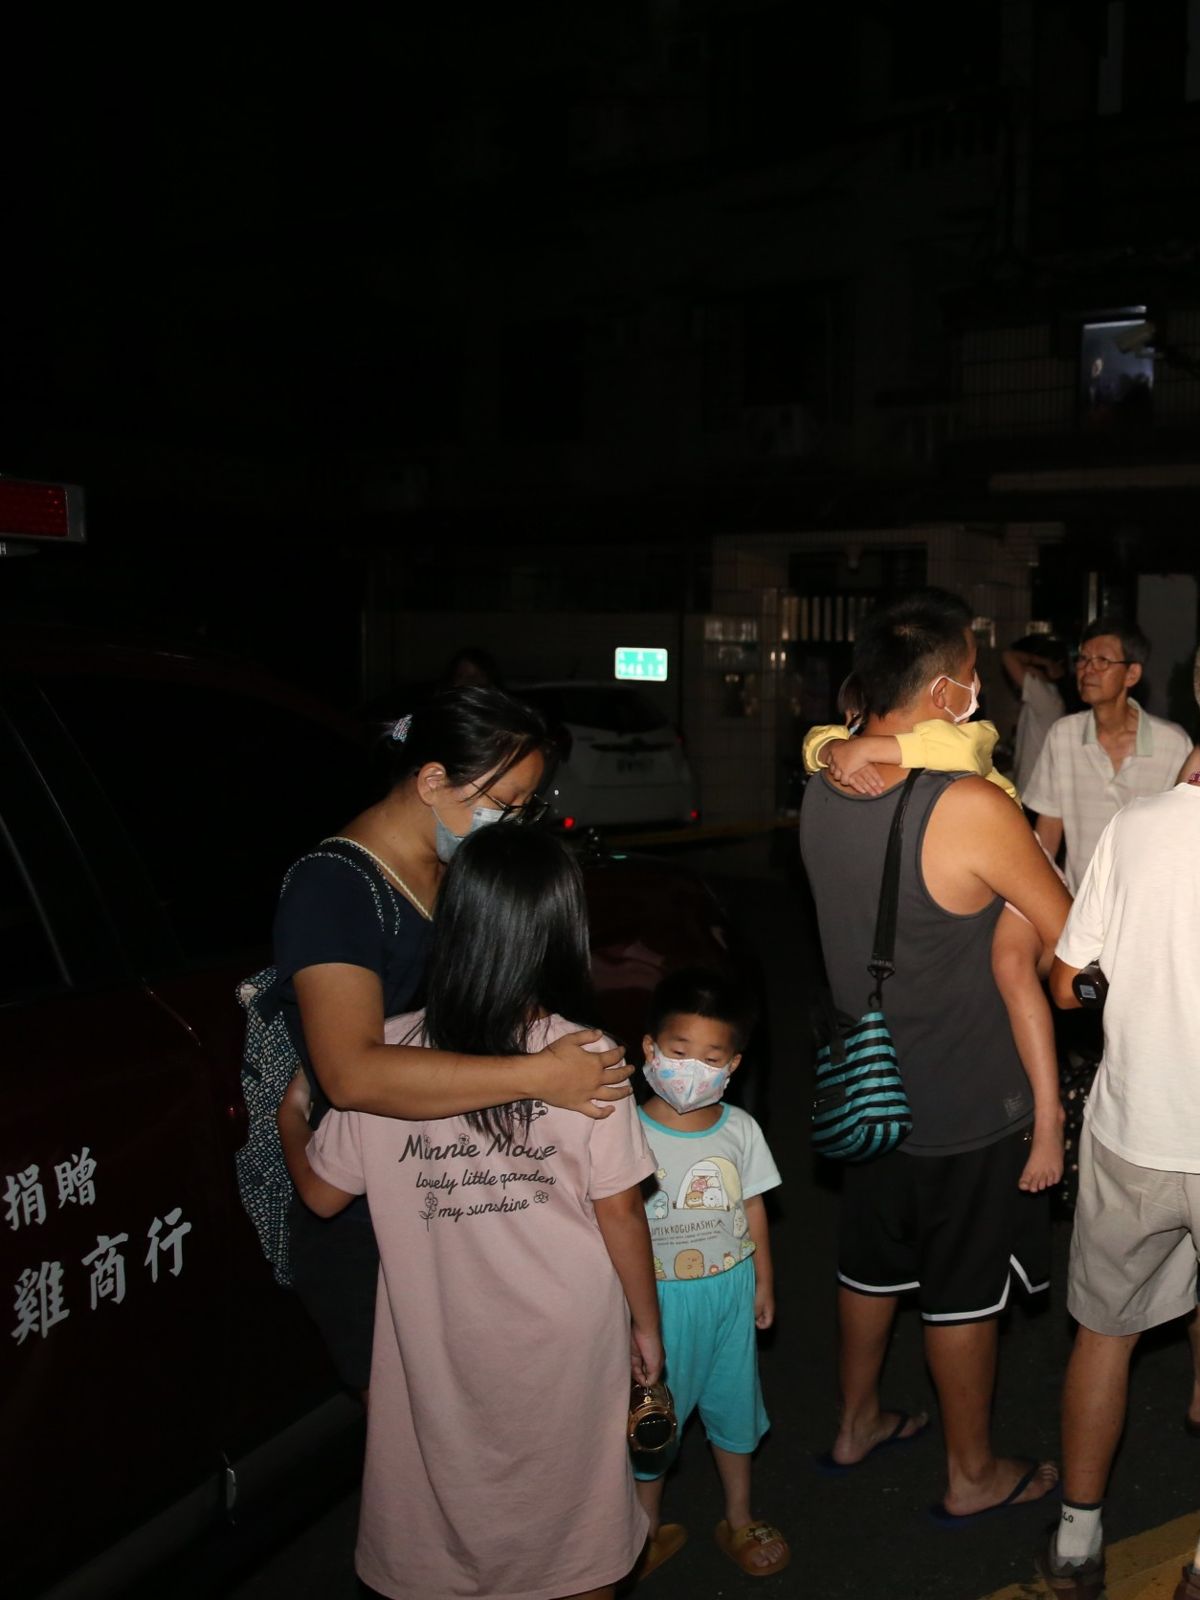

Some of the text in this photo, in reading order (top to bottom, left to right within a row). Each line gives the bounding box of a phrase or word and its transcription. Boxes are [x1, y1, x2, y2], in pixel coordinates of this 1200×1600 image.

[398, 1133, 481, 1162] Minnie
[1, 1146, 97, 1232] 捐贈
[415, 1168, 557, 1195] lovely little garden
[437, 1195, 530, 1223] my sunshine
[10, 1206, 192, 1346] 雞商行
